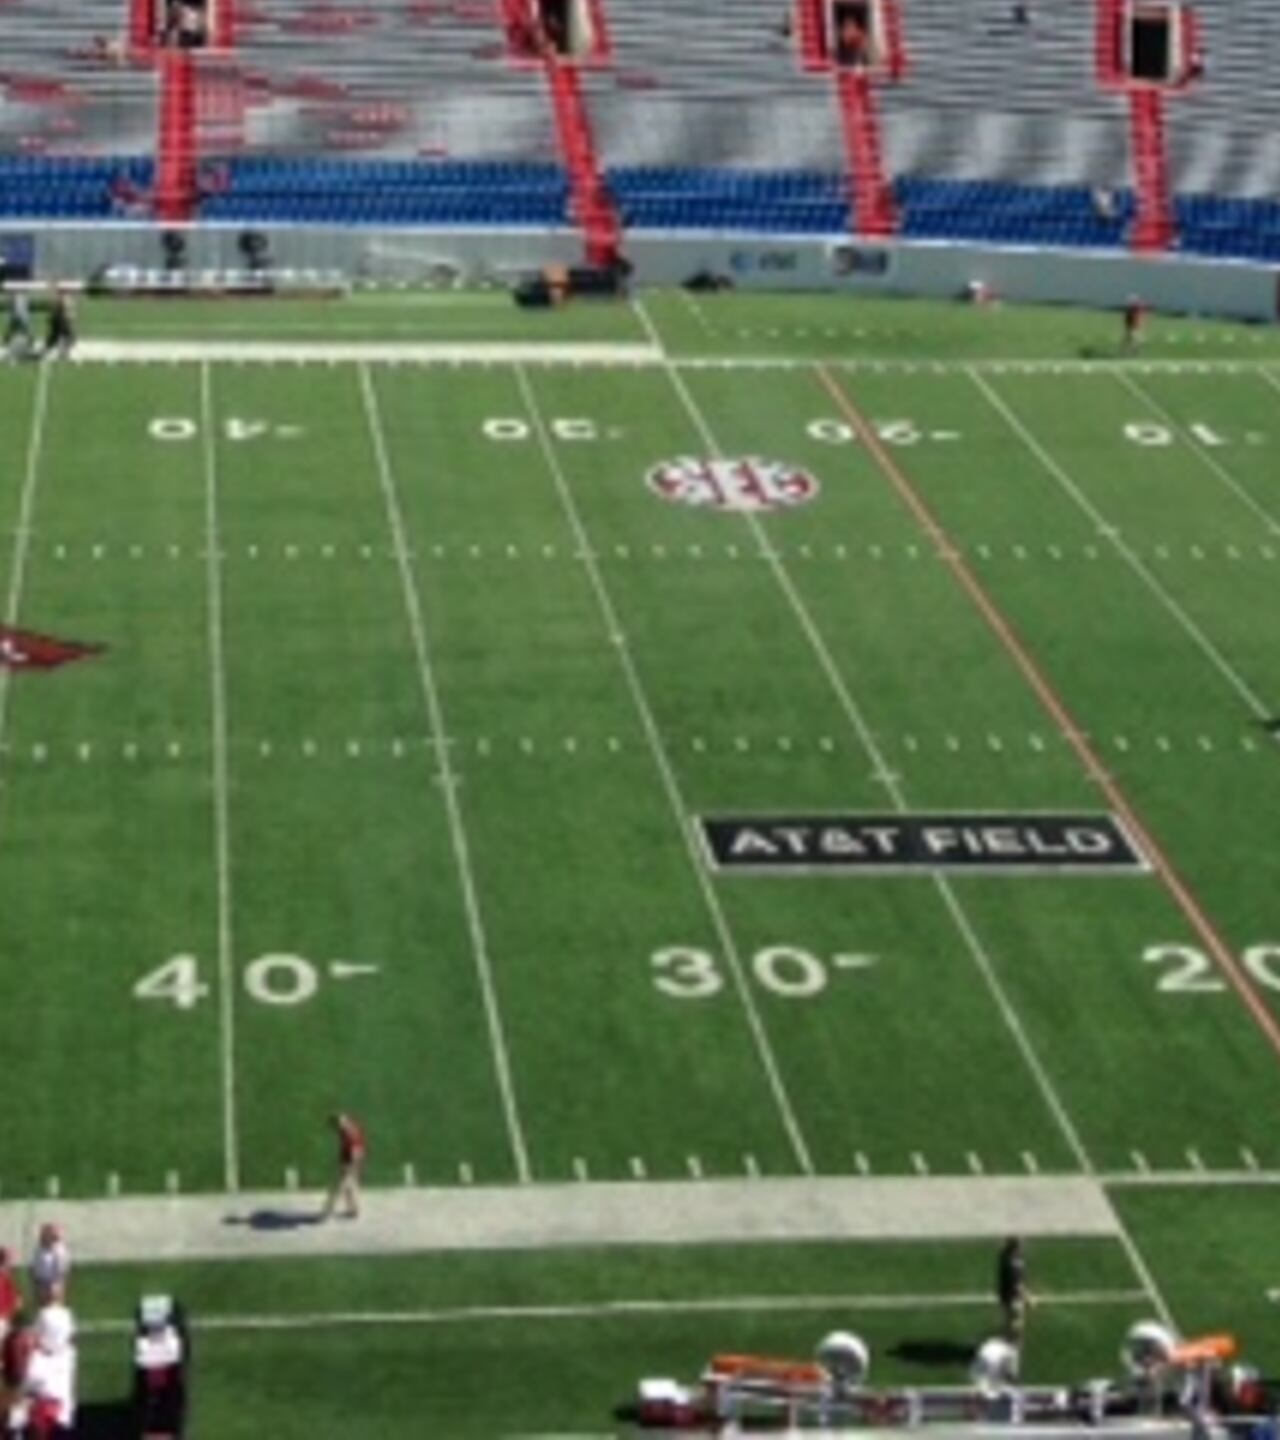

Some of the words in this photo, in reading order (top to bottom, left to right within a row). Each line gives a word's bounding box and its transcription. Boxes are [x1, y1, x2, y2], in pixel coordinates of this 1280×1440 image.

[146, 416, 269, 442] 40
[480, 416, 598, 442] 30
[803, 417, 923, 446] 20
[730, 827, 900, 854] AT&T
[921, 827, 1113, 855] FIELD
[134, 953, 319, 1009] 40
[650, 945, 828, 997] 30
